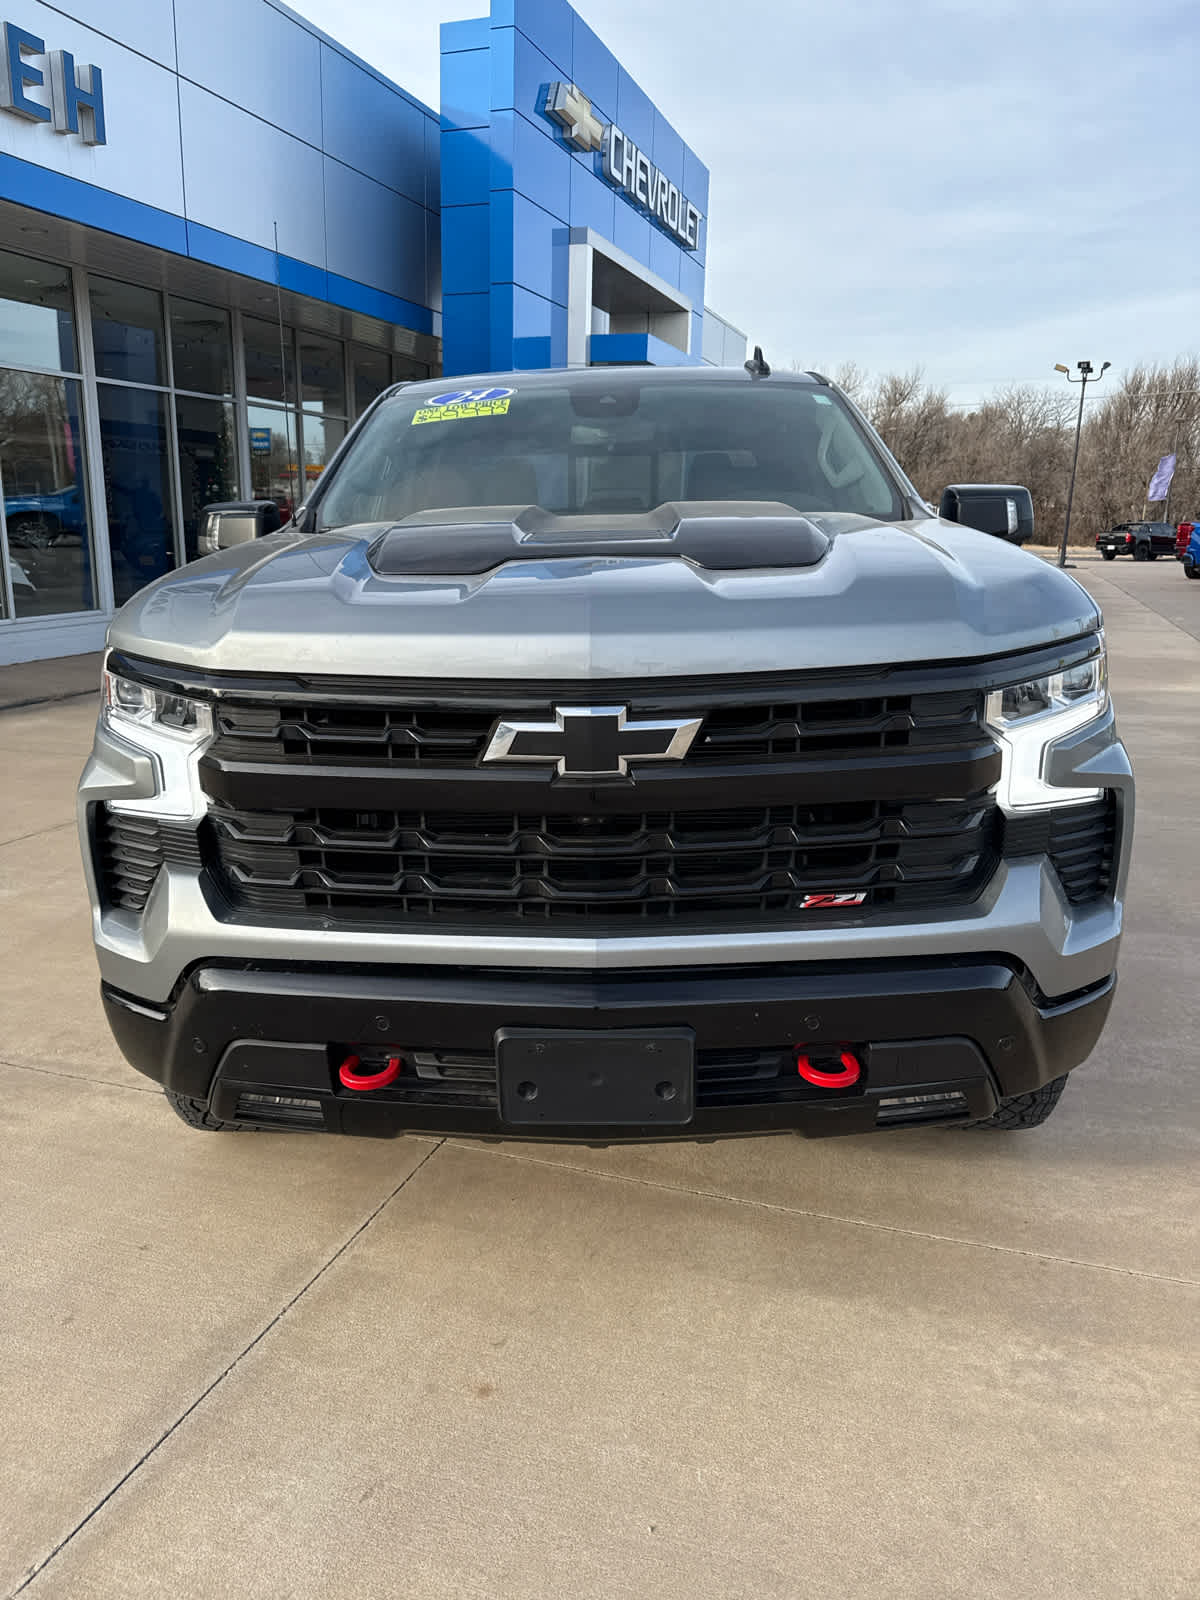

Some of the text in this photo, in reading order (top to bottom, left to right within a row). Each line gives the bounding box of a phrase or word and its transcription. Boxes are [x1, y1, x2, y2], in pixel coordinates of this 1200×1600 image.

[3, 21, 106, 147] EH
[607, 123, 703, 251] CHEVROLET
[800, 892, 867, 908] Z71
